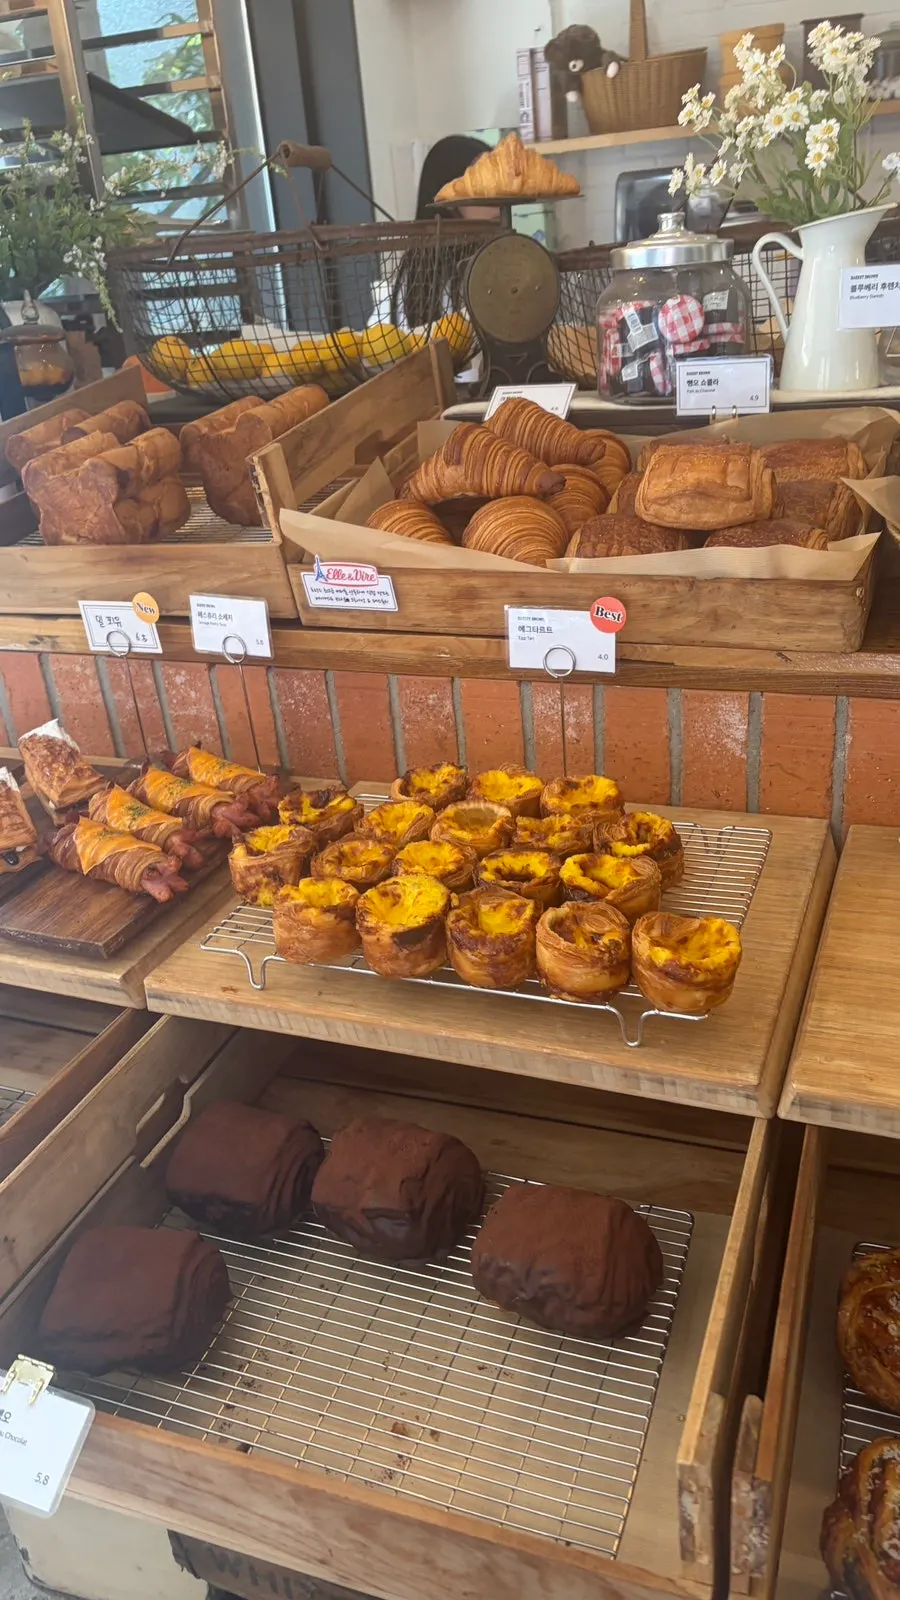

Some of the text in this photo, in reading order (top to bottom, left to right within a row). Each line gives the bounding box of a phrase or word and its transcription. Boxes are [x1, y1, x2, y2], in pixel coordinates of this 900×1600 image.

[850, 282, 878, 293] 블루베리
[136, 602, 155, 614] New
[595, 606, 622, 622] Best
[518, 625, 553, 633] 에그타르트
[34, 1472, 50, 1485] 5.8
